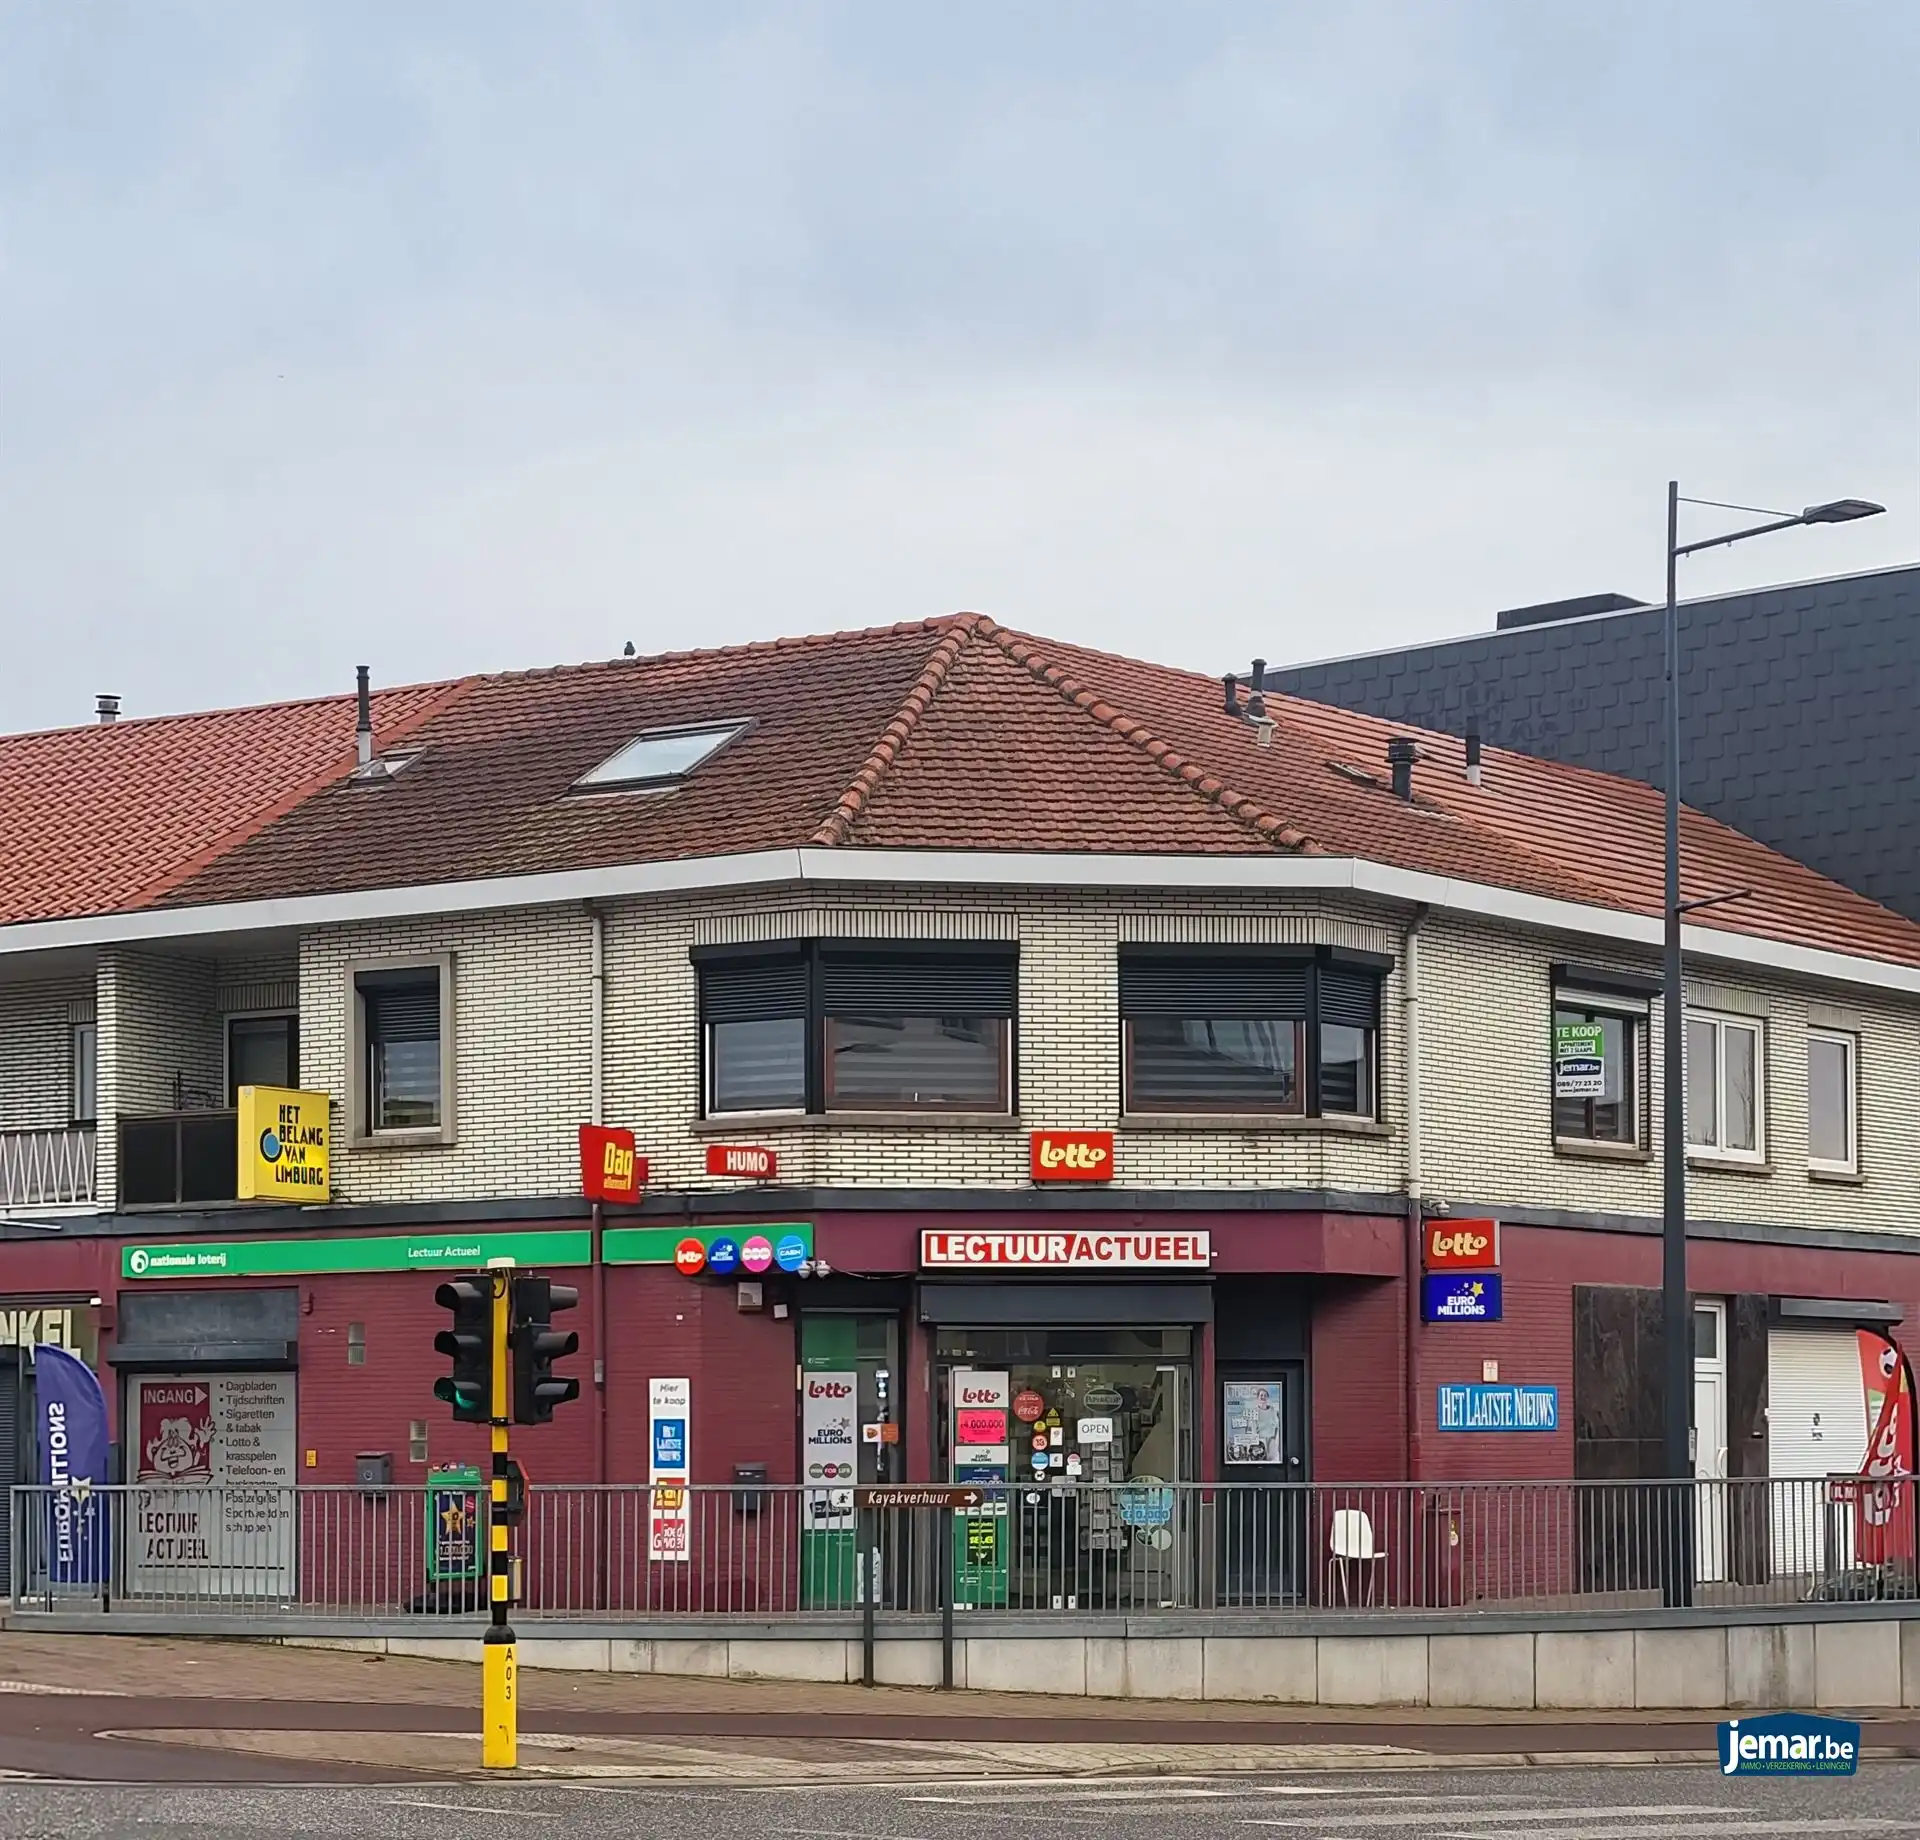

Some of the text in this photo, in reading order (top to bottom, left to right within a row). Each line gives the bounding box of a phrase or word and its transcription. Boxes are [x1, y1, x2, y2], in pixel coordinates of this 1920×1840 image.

[1556, 1026, 1602, 1038] TE KOOP
[1559, 1060, 1600, 1075] jemar.be
[279, 1104, 300, 1124] HET
[280, 1125, 323, 1146] BELANG
[285, 1145, 306, 1163] VAN
[604, 1142, 633, 1190] Dag
[726, 1150, 768, 1172] HUMO
[275, 1164, 323, 1186] LIMBURG
[407, 1245, 481, 1258] Lectuur Actueel
[930, 1235, 1207, 1262] LECTUUR ACTUEEL
[150, 1253, 227, 1268] nationale loterij
[1446, 1296, 1476, 1306] EURO
[1437, 1305, 1485, 1315] MILLIONS
[226, 1381, 277, 1393] Dagbladen
[659, 1384, 679, 1392] Hier
[143, 1389, 193, 1404] INGANG
[227, 1395, 285, 1407] Tijdschriften
[653, 1396, 686, 1406] te koop
[1441, 1387, 1555, 1427] HET LAATSTE NIEUWS
[226, 1409, 275, 1421] Sigaretten
[226, 1423, 262, 1432] & tabak
[818, 1429, 843, 1437] EURO
[1081, 1424, 1109, 1434] OPEN
[226, 1437, 261, 1447] Lotto &
[808, 1436, 852, 1444] MILLIONS
[226, 1451, 277, 1462] krasspelen
[227, 1465, 285, 1475] Telefoon- en
[868, 1491, 950, 1508] Kayakverhuur
[505, 1647, 513, 1700] A03
